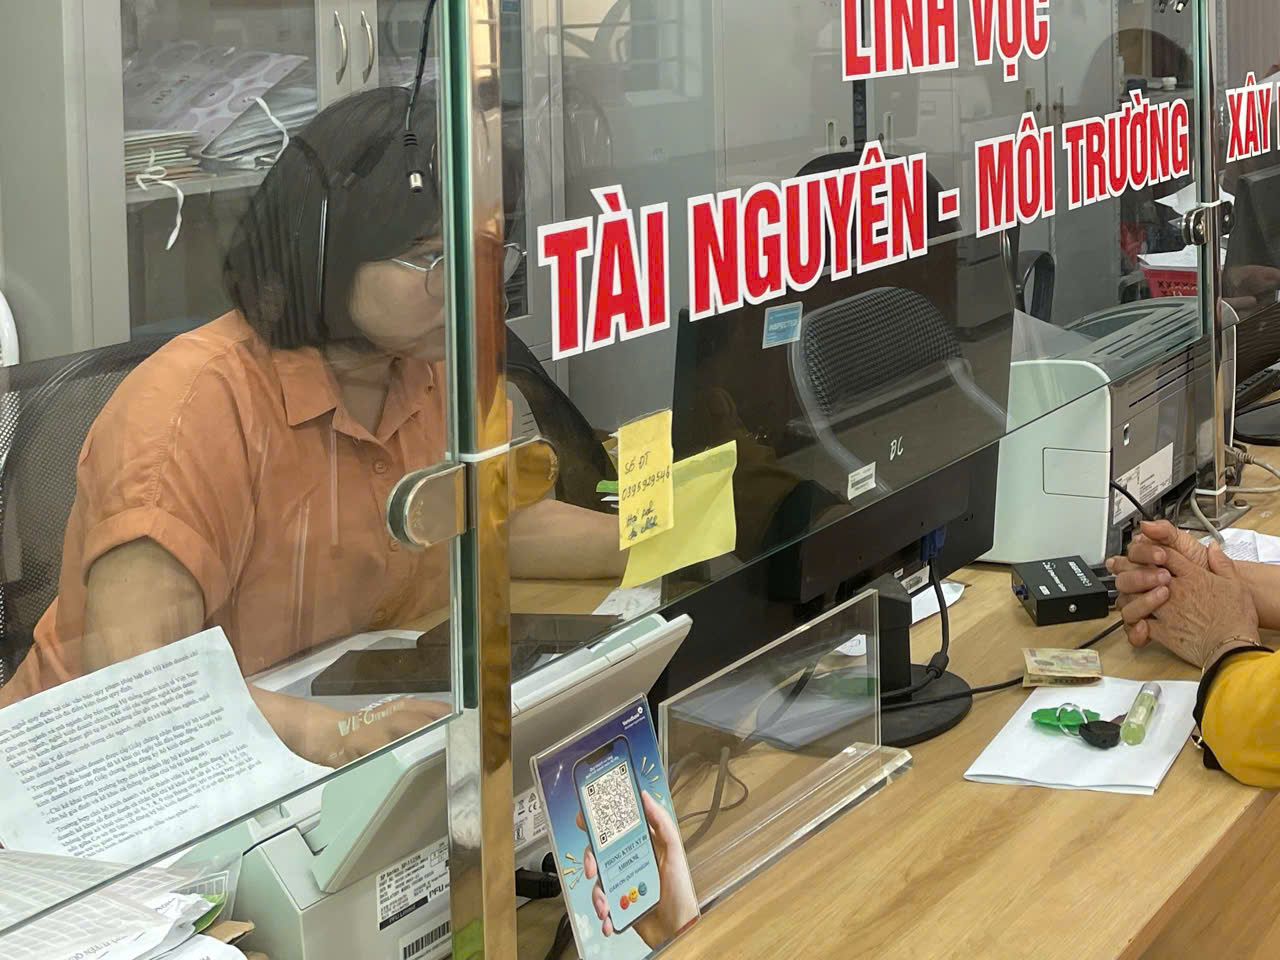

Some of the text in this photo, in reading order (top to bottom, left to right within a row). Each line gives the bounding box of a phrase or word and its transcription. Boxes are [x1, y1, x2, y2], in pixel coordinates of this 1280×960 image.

[1228, 75, 1271, 158] XÂY
[544, 192, 665, 351] TÀI
[692, 147, 924, 313] NGUYÊN
[978, 116, 1053, 230] MÔI
[1065, 93, 1188, 203] TRƯỜNG
